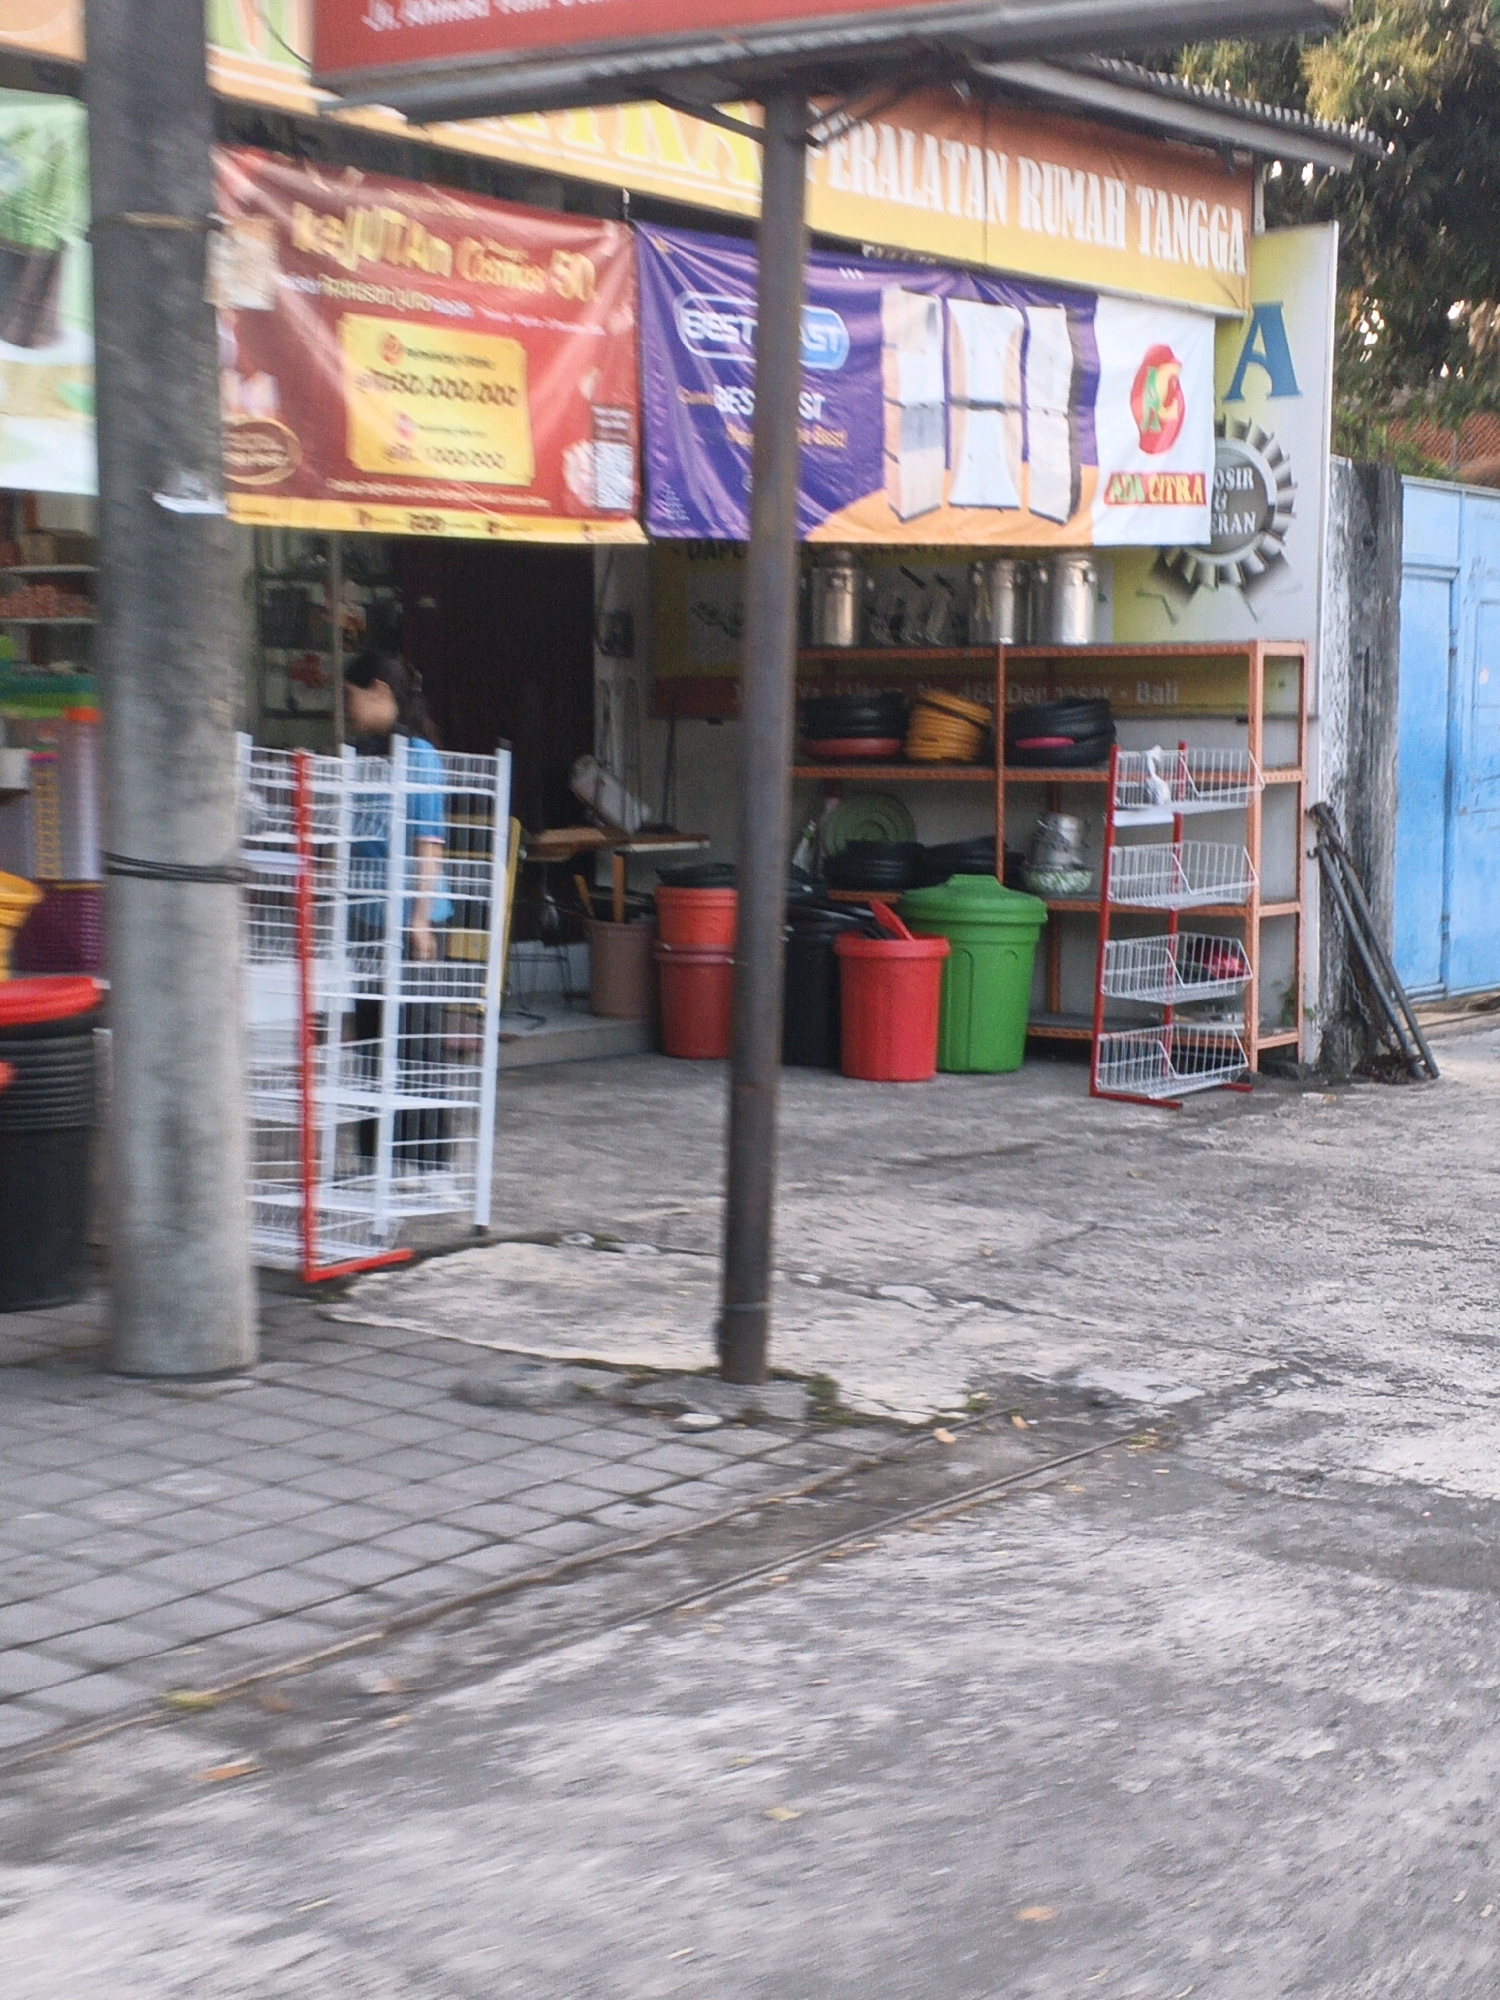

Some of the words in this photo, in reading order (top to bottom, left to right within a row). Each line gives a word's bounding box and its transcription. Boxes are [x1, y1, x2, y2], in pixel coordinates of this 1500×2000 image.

[1018, 155, 1127, 251] RUMAH
[1134, 185, 1247, 277] TANGGA
[1147, 473, 1206, 505] CITRA
[1213, 467, 1255, 491] OSIR
[1135, 680, 1180, 706] Bali
